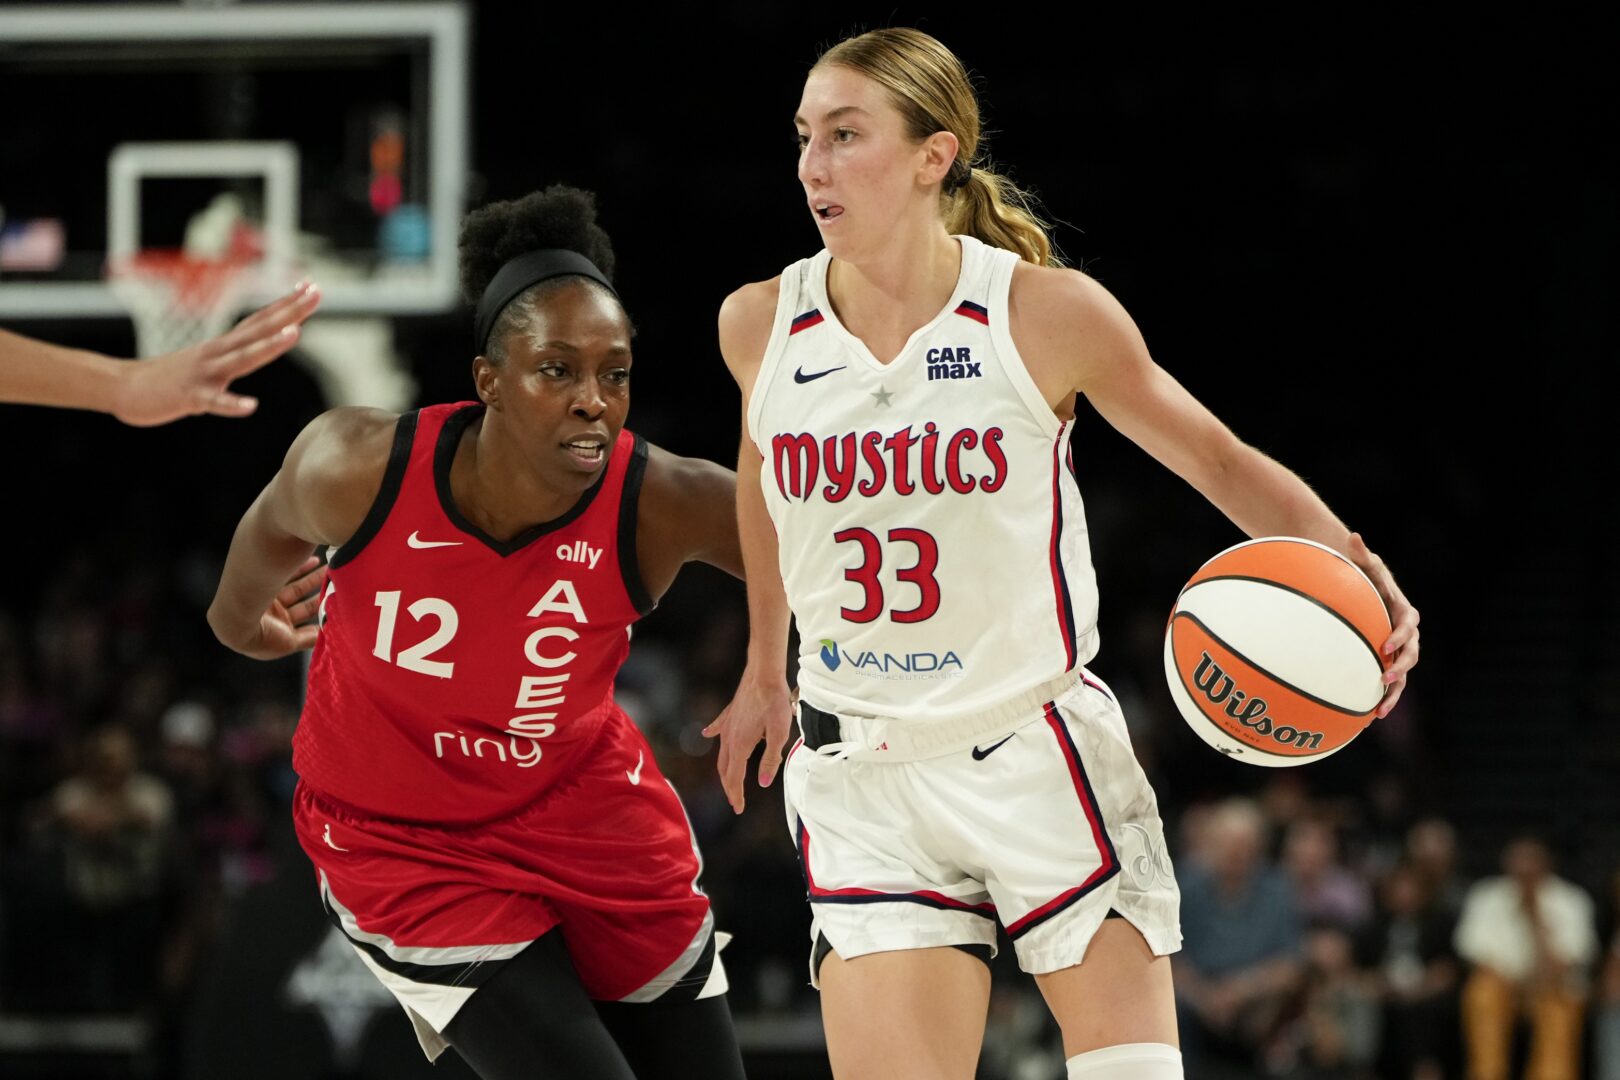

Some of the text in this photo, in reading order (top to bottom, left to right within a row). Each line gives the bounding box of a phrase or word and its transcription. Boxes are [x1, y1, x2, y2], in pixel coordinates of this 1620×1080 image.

[926, 346, 971, 365] CAR
[927, 361, 983, 381] max
[556, 540, 603, 569] ally
[833, 527, 941, 624] 33
[372, 590, 459, 679] 12
[504, 579, 589, 739] ACES
[842, 650, 963, 672] VANDA
[1193, 650, 1324, 748] Wilson
